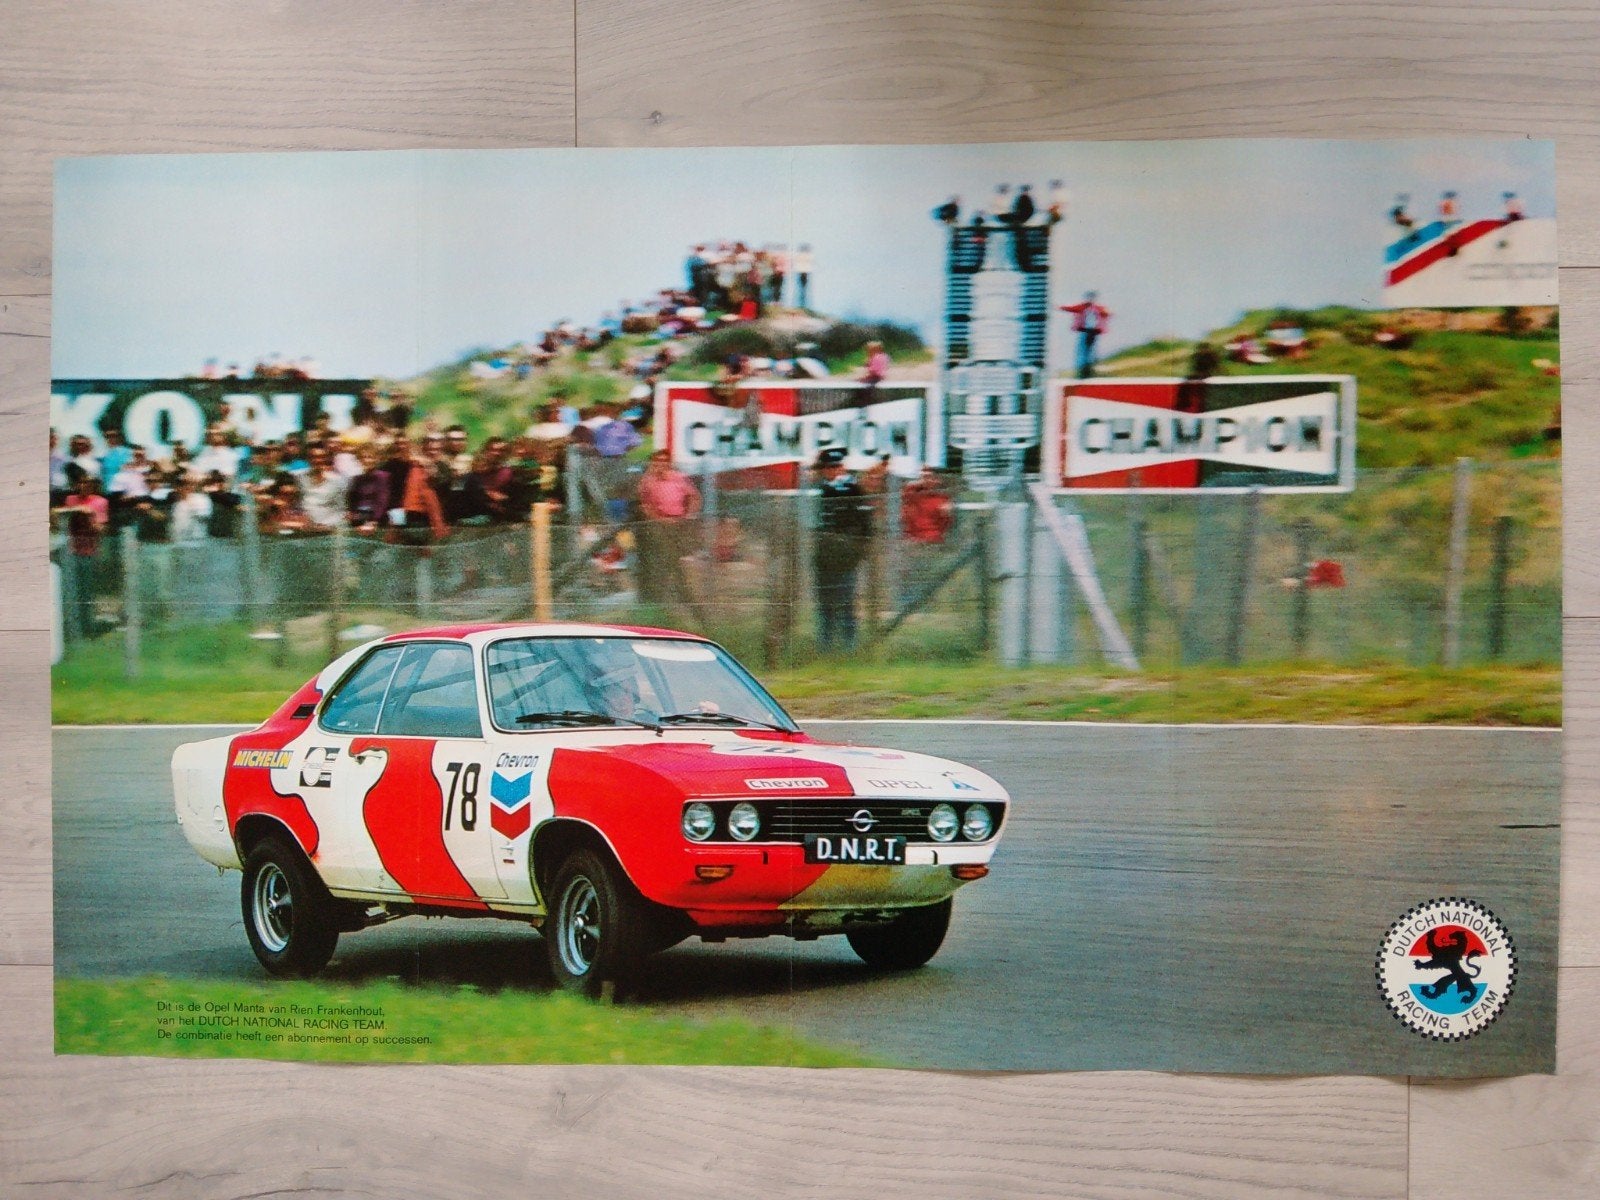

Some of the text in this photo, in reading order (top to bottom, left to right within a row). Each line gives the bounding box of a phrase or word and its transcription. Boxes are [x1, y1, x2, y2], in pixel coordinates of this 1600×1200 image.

[51, 391, 356, 460] KONI
[1080, 417, 1322, 454] CHAMPION
[685, 421, 908, 457] CHAMPION
[233, 750, 293, 768] MICHELIN
[496, 752, 539, 768] Chevron
[749, 778, 825, 789] Chevron
[868, 779, 933, 790] OPEL
[445, 762, 481, 831] 78
[816, 837, 901, 861] D.N.R.T.
[1392, 910, 1502, 958] DUTCH NATIONAL
[157, 1001, 385, 1017] Dit is de Opel Manta van Rien Frankenhout,
[1396, 989, 1499, 1030] RACING TEAM
[157, 1016, 388, 1031] van het DUTCH NATIONAL RACING TEAM.
[157, 1029, 433, 1046] De combinatie heeft een abonnement op successen.
